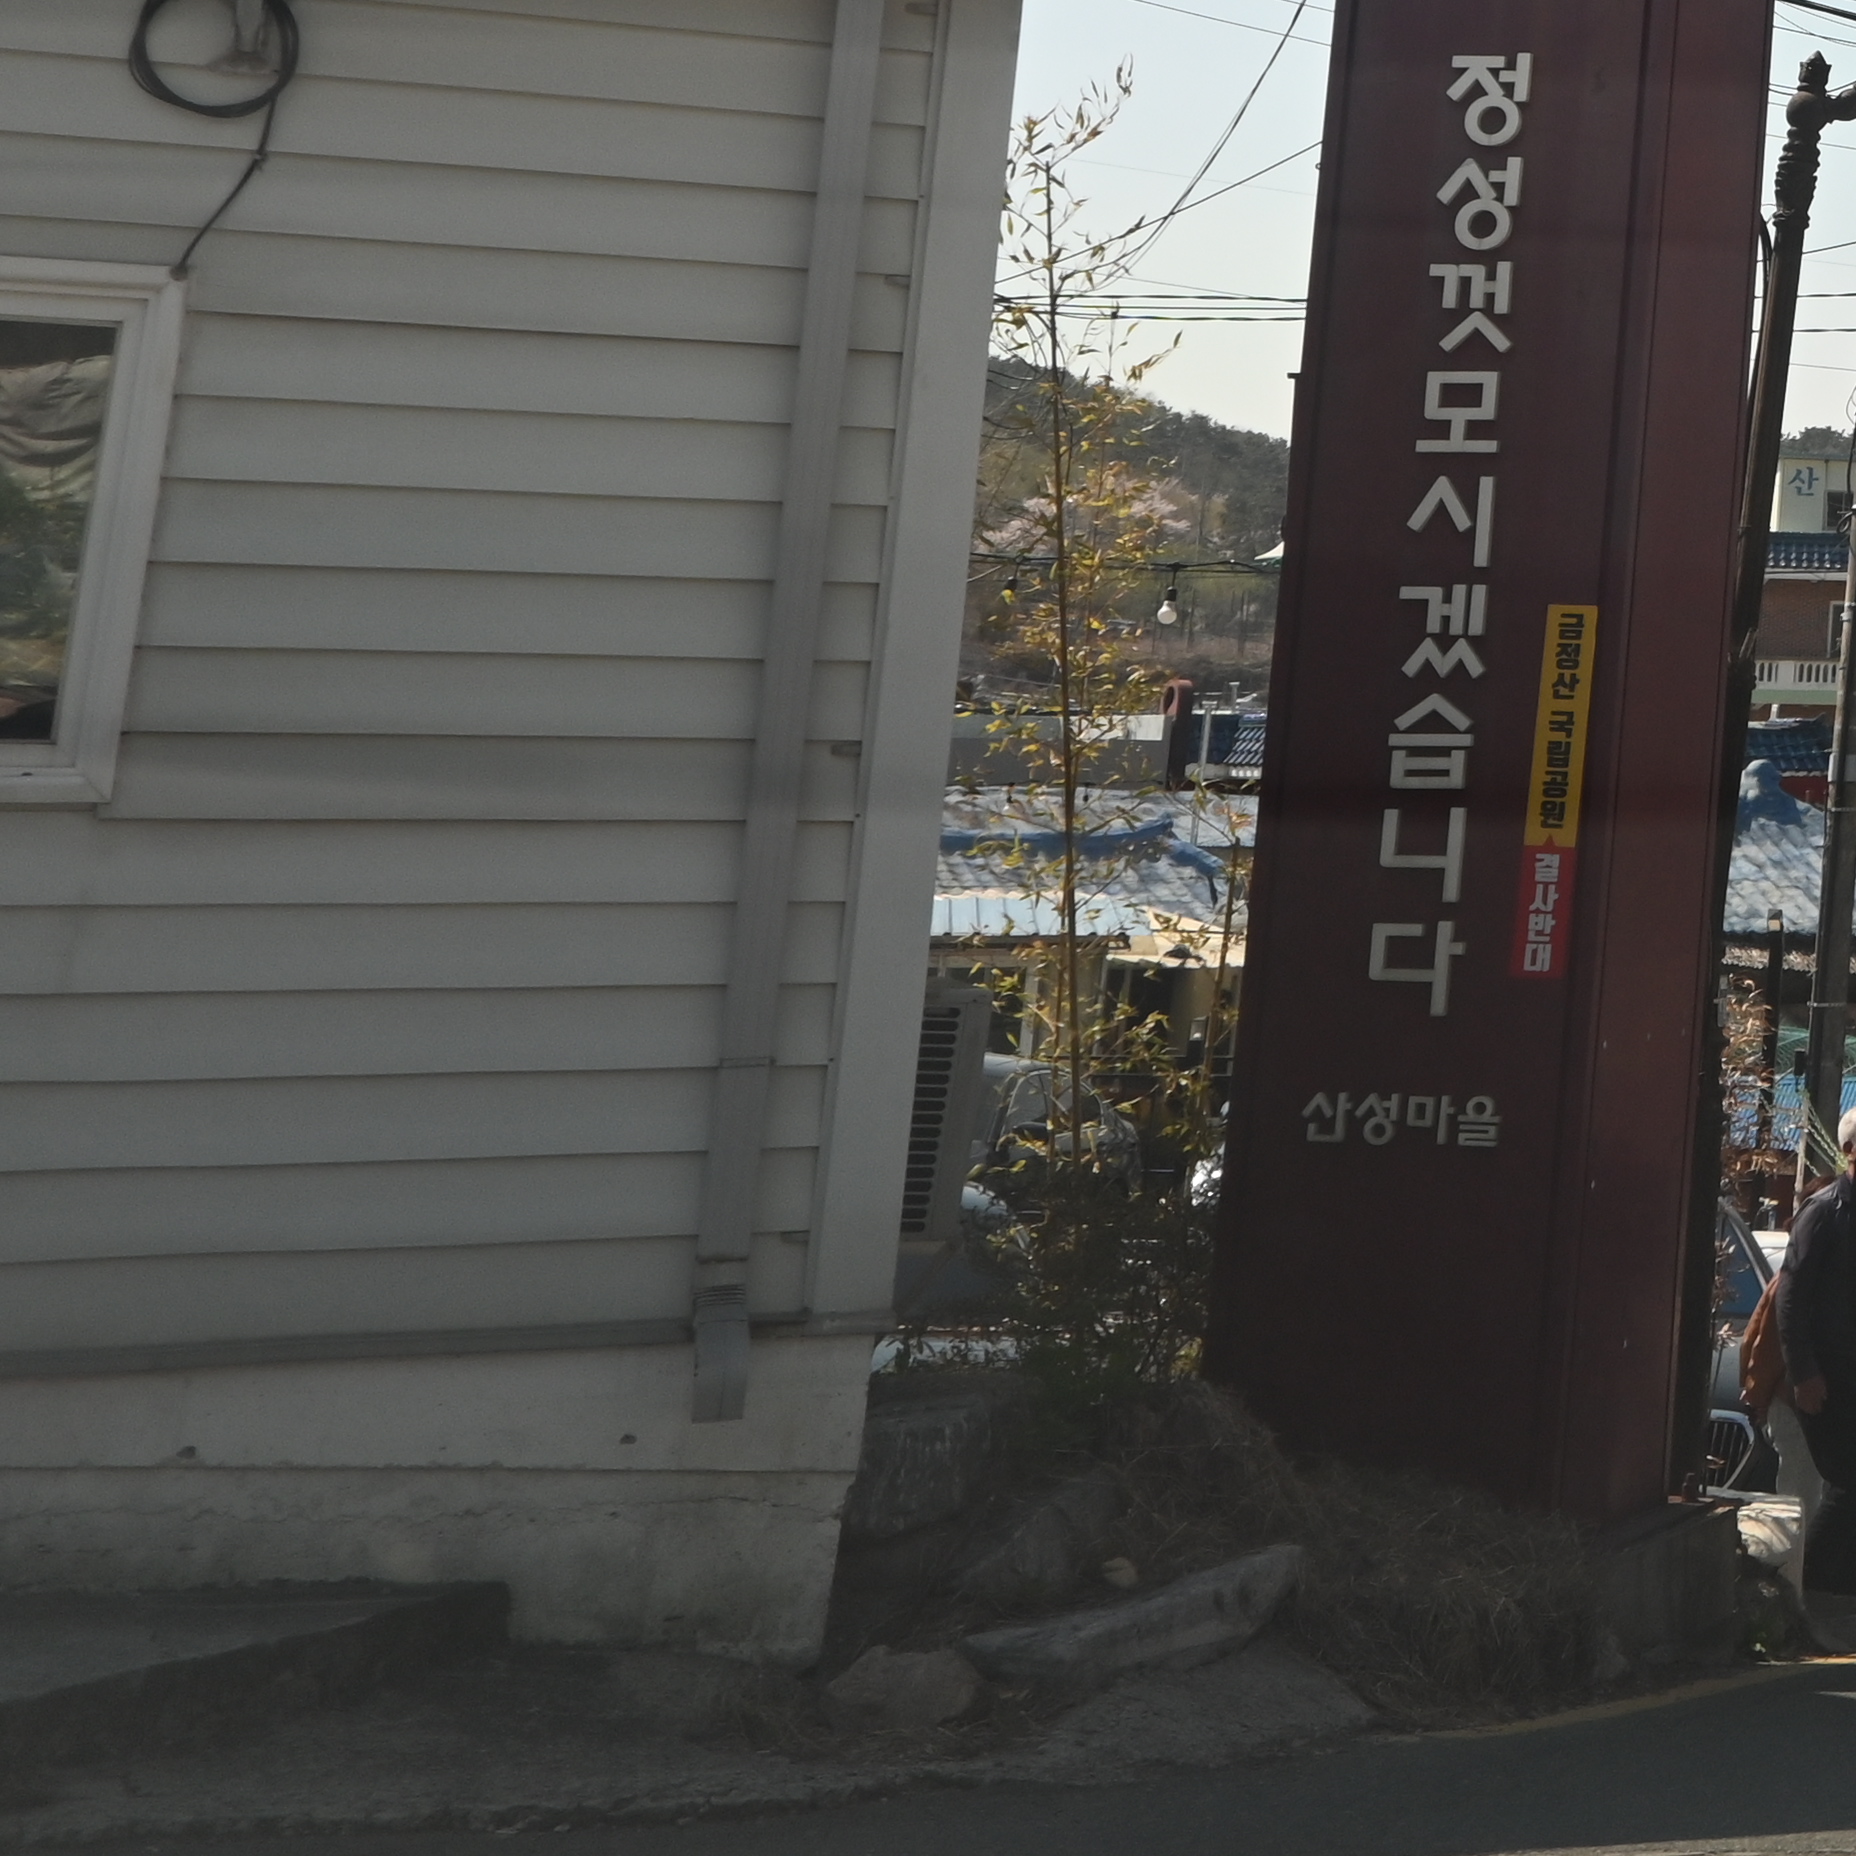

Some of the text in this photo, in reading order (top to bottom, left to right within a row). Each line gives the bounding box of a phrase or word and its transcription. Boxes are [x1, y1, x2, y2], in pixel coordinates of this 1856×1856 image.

[1540, 612, 1585, 829] 금정산 국립공원
[1522, 853, 1561, 974] 결사반대
[1302, 1091, 1501, 1148] 산성마을
